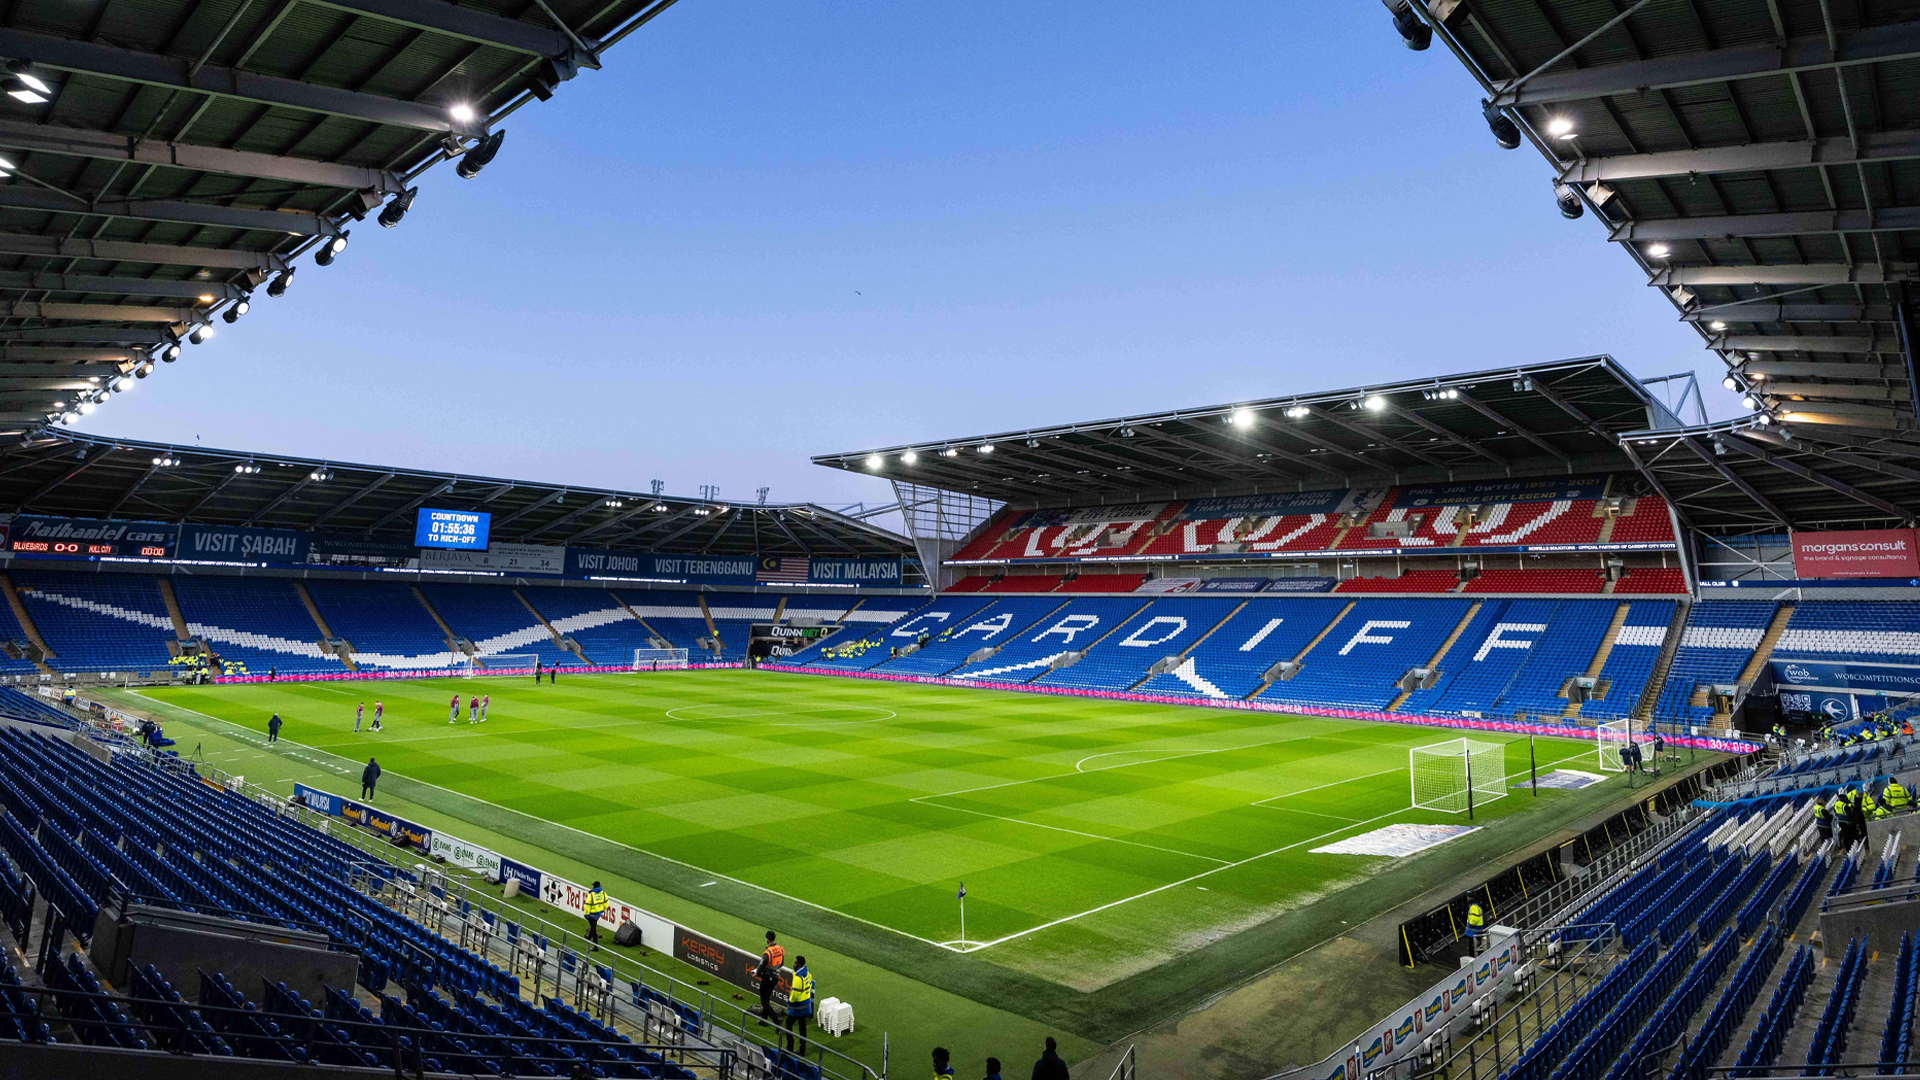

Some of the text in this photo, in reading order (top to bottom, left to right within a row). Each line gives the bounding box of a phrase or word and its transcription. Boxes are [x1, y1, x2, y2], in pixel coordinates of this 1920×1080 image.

[1408, 488, 1434, 496] PHIL
[1474, 483, 1520, 492] DWYER
[1197, 498, 1222, 506] CITY
[1298, 491, 1335, 500] MORE
[1434, 492, 1557, 504] CARDIFF CITY LEGEND
[1107, 510, 1152, 518] LEGEND
[1193, 504, 1225, 512] THAN
[431, 512, 479, 522] COUNTDOWN
[23, 521, 164, 542] Nathaniel cars
[432, 522, 475, 535] 01:55:36
[194, 532, 297, 556] VISIT SABAH
[428, 534, 439, 542] TO
[13, 542, 48, 552] BLUEBIRDS
[54, 543, 78, 552] 0-0
[142, 546, 164, 556] 00:00
[1802, 540, 1906, 554] morgans consult
[425, 551, 471, 562] BERJAYA
[578, 554, 638, 571] VISIT JOHOR
[655, 558, 753, 576] VISIT TERENGGANU
[812, 562, 898, 578] VISIT MALAYSIA
[771, 626, 820, 637] QUINNBET
[891, 612, 1547, 662] CARDIFF
[402, 670, 414, 678] OFF
[1790, 668, 1809, 676] wob
[1225, 700, 1238, 708] OFF
[1240, 700, 1250, 708] ALL
[1710, 739, 1730, 750] 30%
[1733, 742, 1751, 753] OFF
[311, 792, 330, 811] MALAYSIA
[440, 841, 451, 852] EVANS
[462, 850, 474, 860] EVANS
[485, 858, 499, 870] EVANS
[566, 886, 580, 910] Ted
[682, 936, 725, 964] KERRY
[687, 952, 718, 971] LOGISTICS
